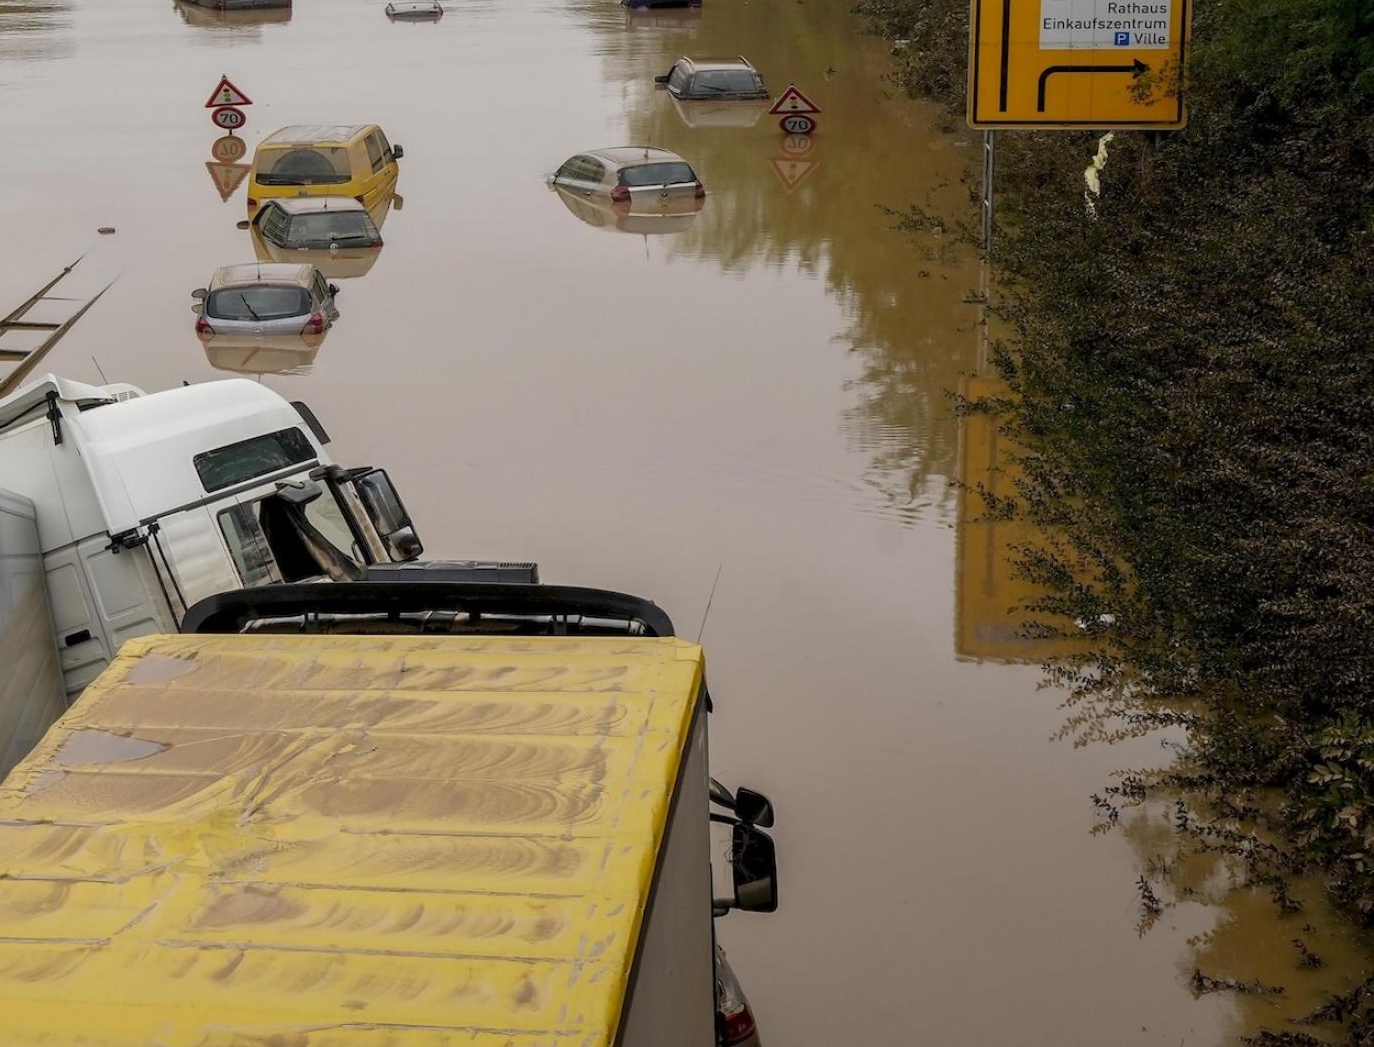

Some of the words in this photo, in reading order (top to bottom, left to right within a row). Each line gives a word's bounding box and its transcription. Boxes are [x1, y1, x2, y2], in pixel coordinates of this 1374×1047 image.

[1107, 2, 1167, 14] Rathaus
[1043, 17, 1167, 30] Einkaufszentrum
[1134, 33, 1166, 45] Ville
[220, 113, 238, 124] 70
[787, 120, 808, 130] 70
